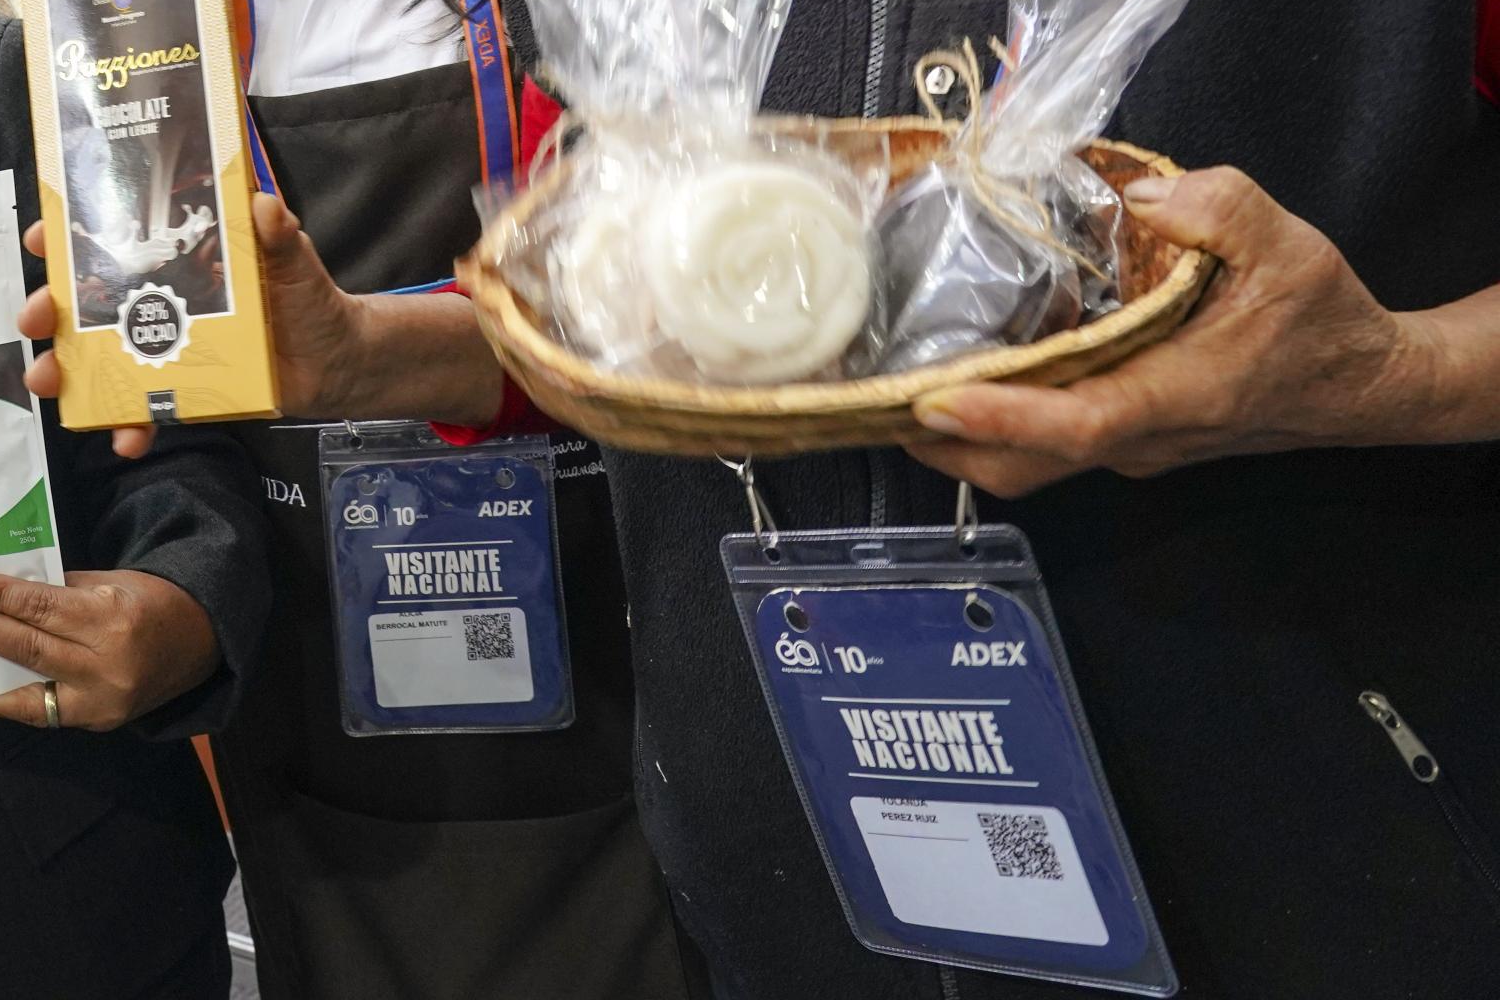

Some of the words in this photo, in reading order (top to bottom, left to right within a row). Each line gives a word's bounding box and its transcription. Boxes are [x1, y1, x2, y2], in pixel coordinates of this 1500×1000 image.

[56, 42, 200, 90] Pazziones
[131, 322, 178, 345] CACAO
[261, 476, 307, 507] IDA
[393, 506, 415, 526] 10
[478, 500, 533, 518] ADEX
[384, 549, 501, 576] VISITANTE
[388, 572, 503, 596] NACIONAL
[376, 622, 417, 630] BERROCAL
[418, 620, 448, 628] MATUTE
[834, 646, 867, 674] 10
[951, 641, 1027, 668] ADEX
[840, 708, 1003, 744] VISITANTE
[853, 739, 1014, 775] NACIONAL
[881, 812, 913, 822] PEREZ
